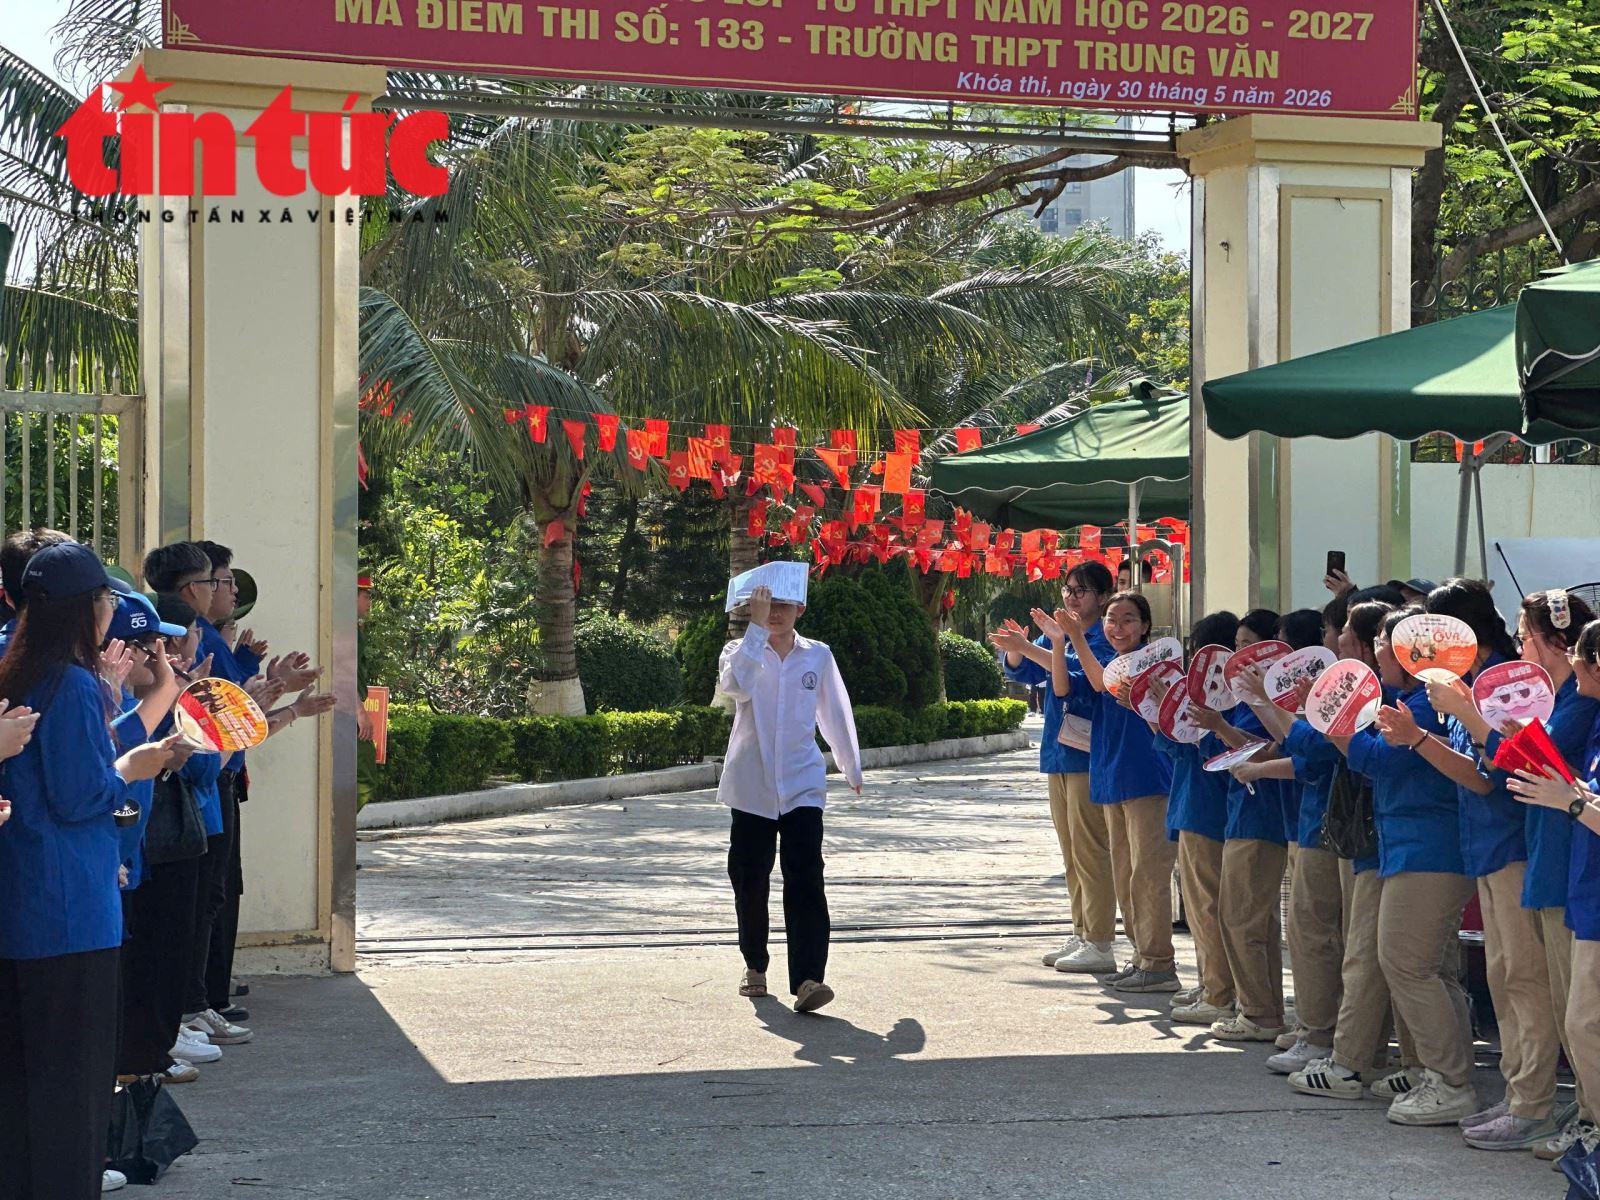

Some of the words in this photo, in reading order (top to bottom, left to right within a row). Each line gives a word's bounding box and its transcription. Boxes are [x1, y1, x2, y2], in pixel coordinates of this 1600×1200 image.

[1075, 0, 1149, 35] HỌC
[1161, 2, 1249, 36] 2026
[1262, 20, 1274, 28] -
[1287, 9, 1374, 41] 2027
[537, 5, 600, 40] THI
[614, 3, 679, 46] SỐ:
[694, 17, 764, 50] 133
[805, 21, 958, 63] TRƯỜNG
[971, 34, 1063, 68] THPT
[1074, 40, 1196, 76] TRUNG
[1207, 42, 1279, 79] VĂN
[957, 71, 1013, 93] Khóa
[1019, 75, 1052, 97] thi,
[1059, 77, 1112, 101] ngày
[1117, 80, 1143, 99] 30
[1148, 81, 1208, 106] tháng
[1213, 85, 1227, 103] 5
[1232, 86, 1275, 104] năm
[1283, 88, 1332, 107] 2026
[131, 616, 148, 629] 5G
